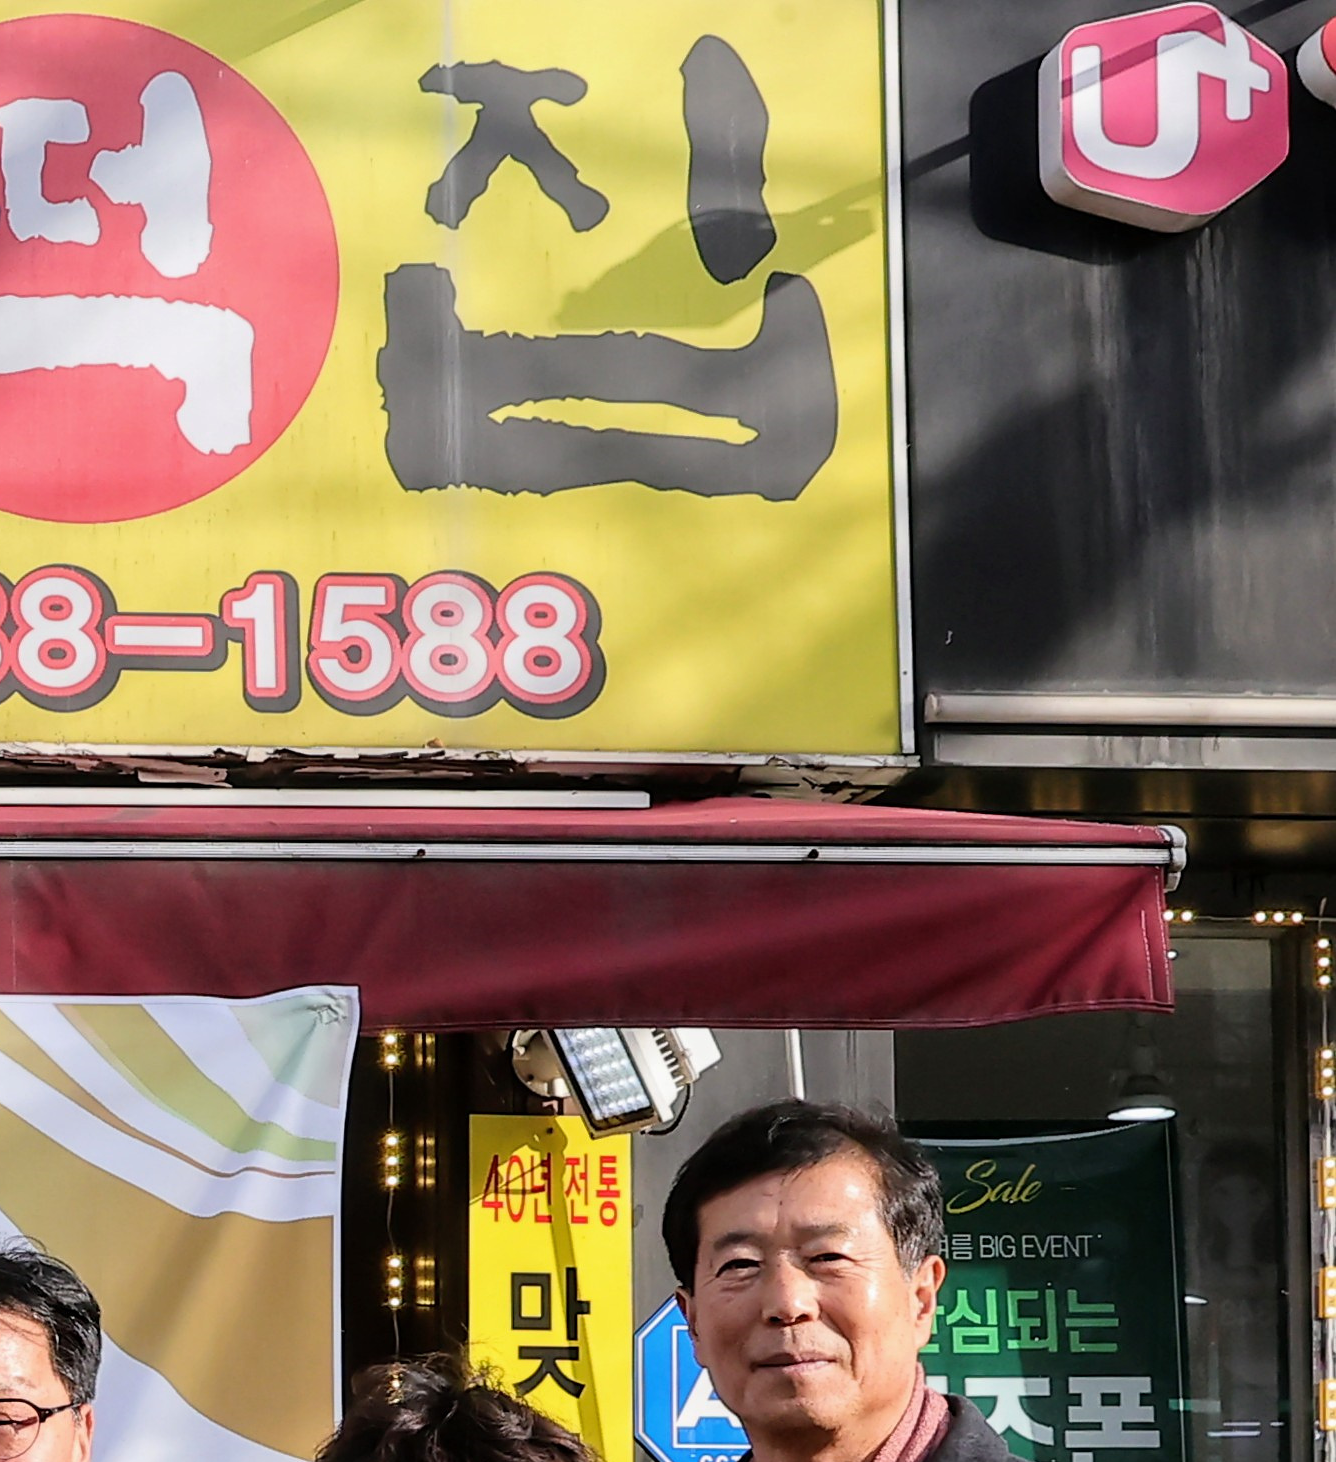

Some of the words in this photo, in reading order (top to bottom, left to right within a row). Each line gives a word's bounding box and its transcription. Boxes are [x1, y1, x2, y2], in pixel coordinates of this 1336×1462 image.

[482, 1152, 553, 1224] 40년
[563, 1152, 621, 1227] 전통
[946, 1159, 1043, 1214] Sale
[979, 1235, 1017, 1258] BIG
[1022, 1235, 1093, 1258] EVENT
